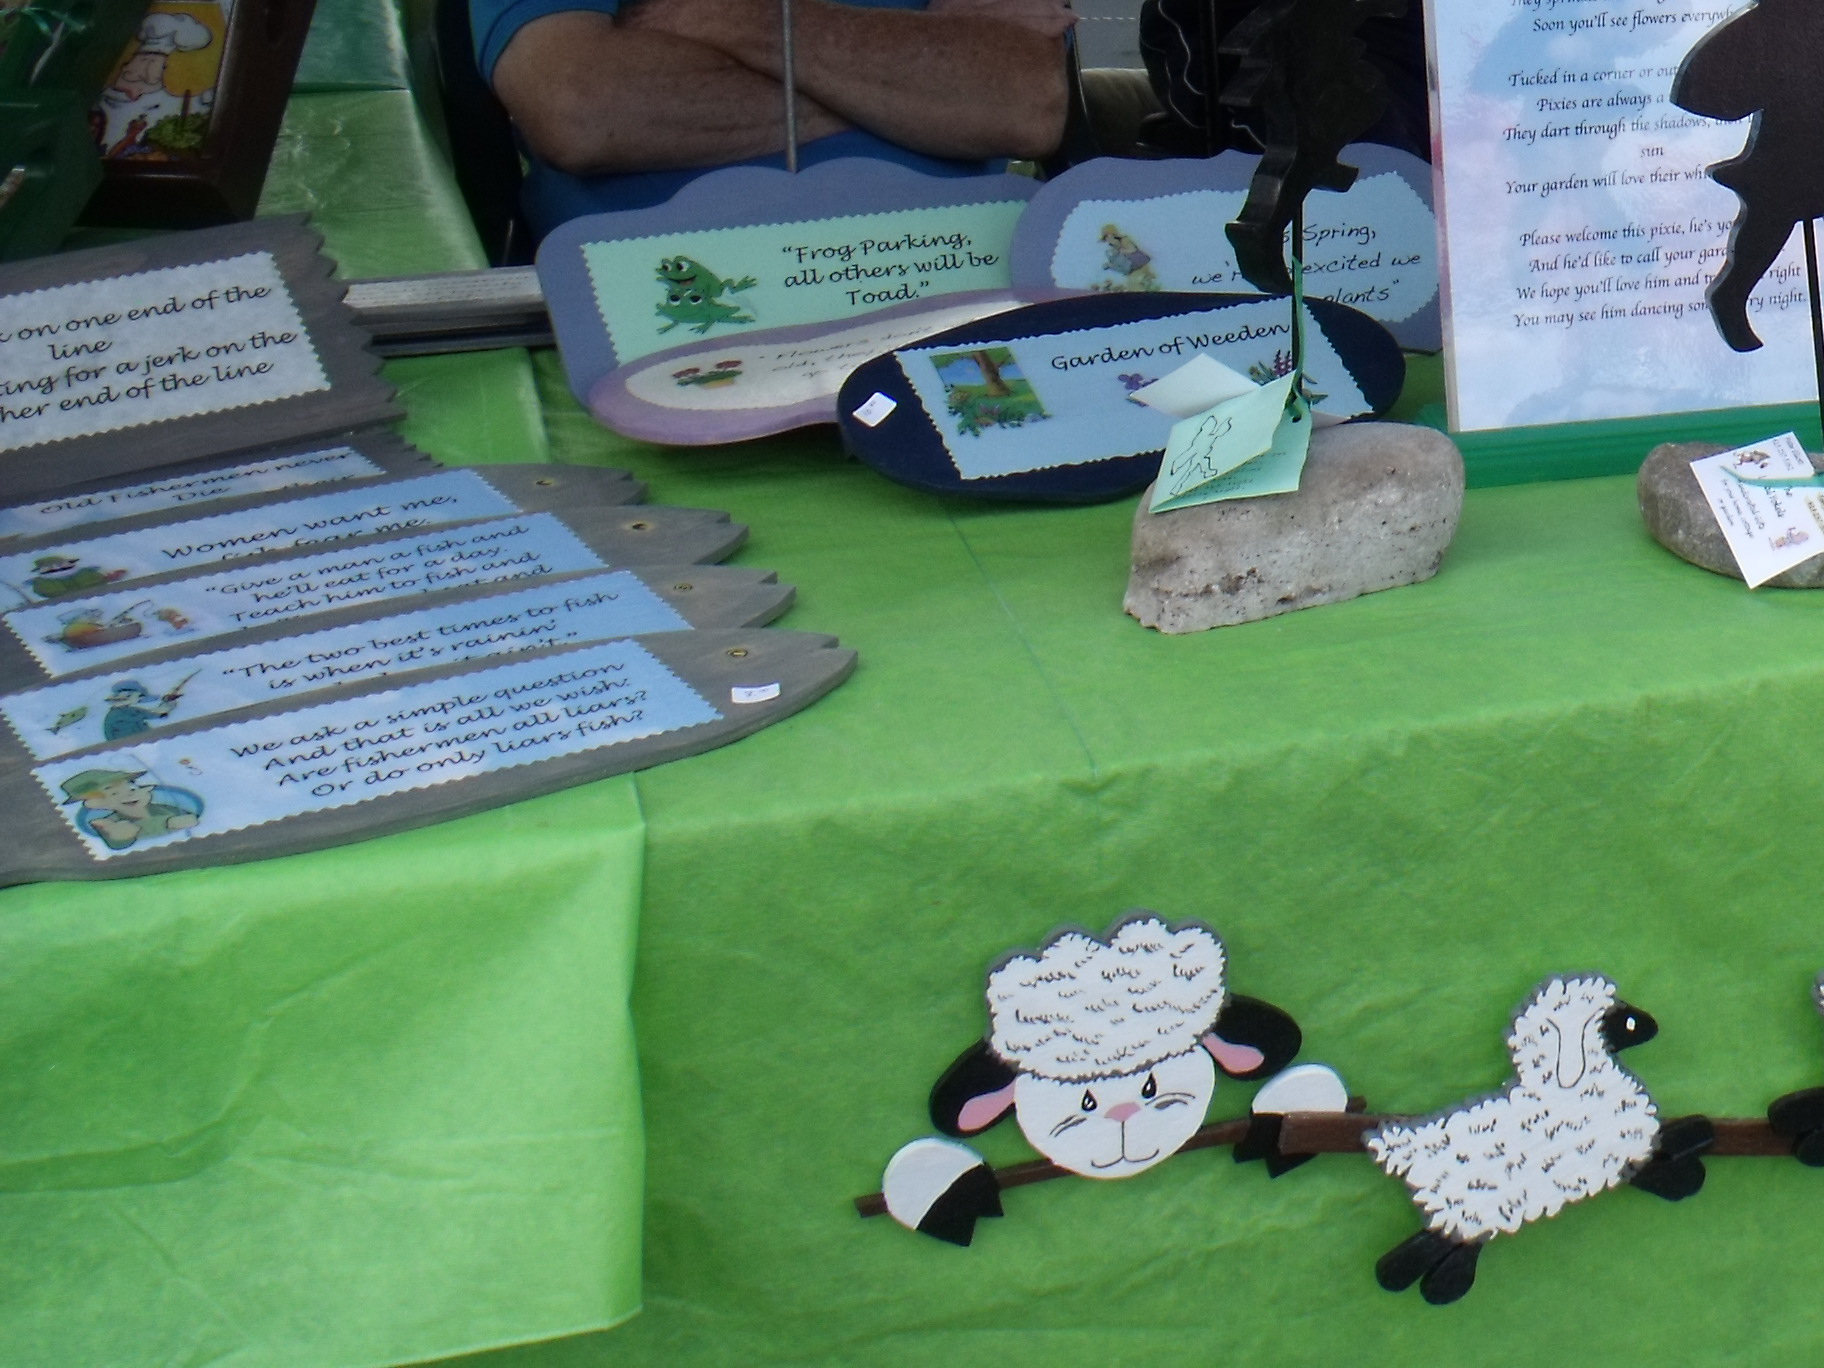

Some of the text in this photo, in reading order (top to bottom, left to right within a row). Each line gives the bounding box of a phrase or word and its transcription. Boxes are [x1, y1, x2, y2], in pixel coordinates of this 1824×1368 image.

[1532, 16, 1566, 33] Soon
[1610, 14, 1629, 29] see
[1630, 7, 1678, 34] flowers
[1507, 67, 1559, 88] Tucked
[1592, 68, 1635, 84] corner
[1536, 96, 1578, 113] Pixies
[1581, 96, 1604, 109] are
[1607, 89, 1653, 112] always
[1502, 123, 1537, 146] They
[1540, 120, 1571, 139] dart
[1575, 116, 1627, 140] through
[1630, 114, 1651, 133] the
[1640, 144, 1665, 159] sun
[1505, 179, 1539, 196] Your
[1541, 172, 1590, 198] garden
[1592, 170, 1618, 187] will
[1621, 169, 1646, 186] love
[1648, 166, 1681, 184] their
[1301, 222, 1377, 248] Spring,
[1518, 229, 1562, 248] Please
[1565, 224, 1619, 244] welcome
[1622, 221, 1647, 240] this
[1688, 217, 1713, 234] he's
[783, 250, 1001, 288] all others will be
[1192, 251, 1422, 286] we'r excited we
[1528, 252, 1560, 274] And
[1591, 248, 1618, 268] like
[1620, 250, 1635, 266] to
[1636, 245, 1661, 263] call
[1664, 248, 1698, 269] your
[1515, 285, 1539, 301] We
[1540, 280, 1572, 305] hope
[1615, 273, 1641, 293] love
[1643, 270, 1672, 290] him
[1674, 270, 1702, 287] and
[1767, 263, 1803, 286] right
[17, 322, 62, 342] on
[65, 312, 123, 332] one
[126, 296, 186, 321] end
[191, 288, 221, 310] of
[221, 285, 273, 305] the
[1512, 313, 1542, 328] You
[1543, 312, 1576, 330] may
[1577, 308, 1597, 322] see
[1599, 304, 1628, 322] him
[1629, 299, 1685, 321] dancing
[47, 338, 113, 361] line
[64, 330, 299, 388] for a jerk on the
[1050, 323, 1292, 372] Garden of Weeden
[59, 360, 275, 413] end of the line
[39, 497, 104, 516] Old
[106, 466, 270, 505] Fishermen
[274, 450, 354, 473] never
[162, 524, 299, 560] Women
[303, 504, 393, 531] want
[316, 524, 531, 577] man fish and
[228, 598, 322, 624] Teach
[323, 584, 387, 606] him
[388, 577, 418, 593] to
[425, 563, 478, 587] fish
[480, 550, 543, 573] and
[325, 560, 420, 589] eat for
[306, 590, 622, 664] two best times to fish
[267, 656, 396, 692] is when
[228, 660, 627, 759] We ask a simple question
[263, 694, 556, 772] And that is all we
[276, 763, 344, 788] Are
[341, 725, 510, 774] fishermen
[511, 709, 564, 732] all
[309, 707, 647, 799] Or do only liars fish?
